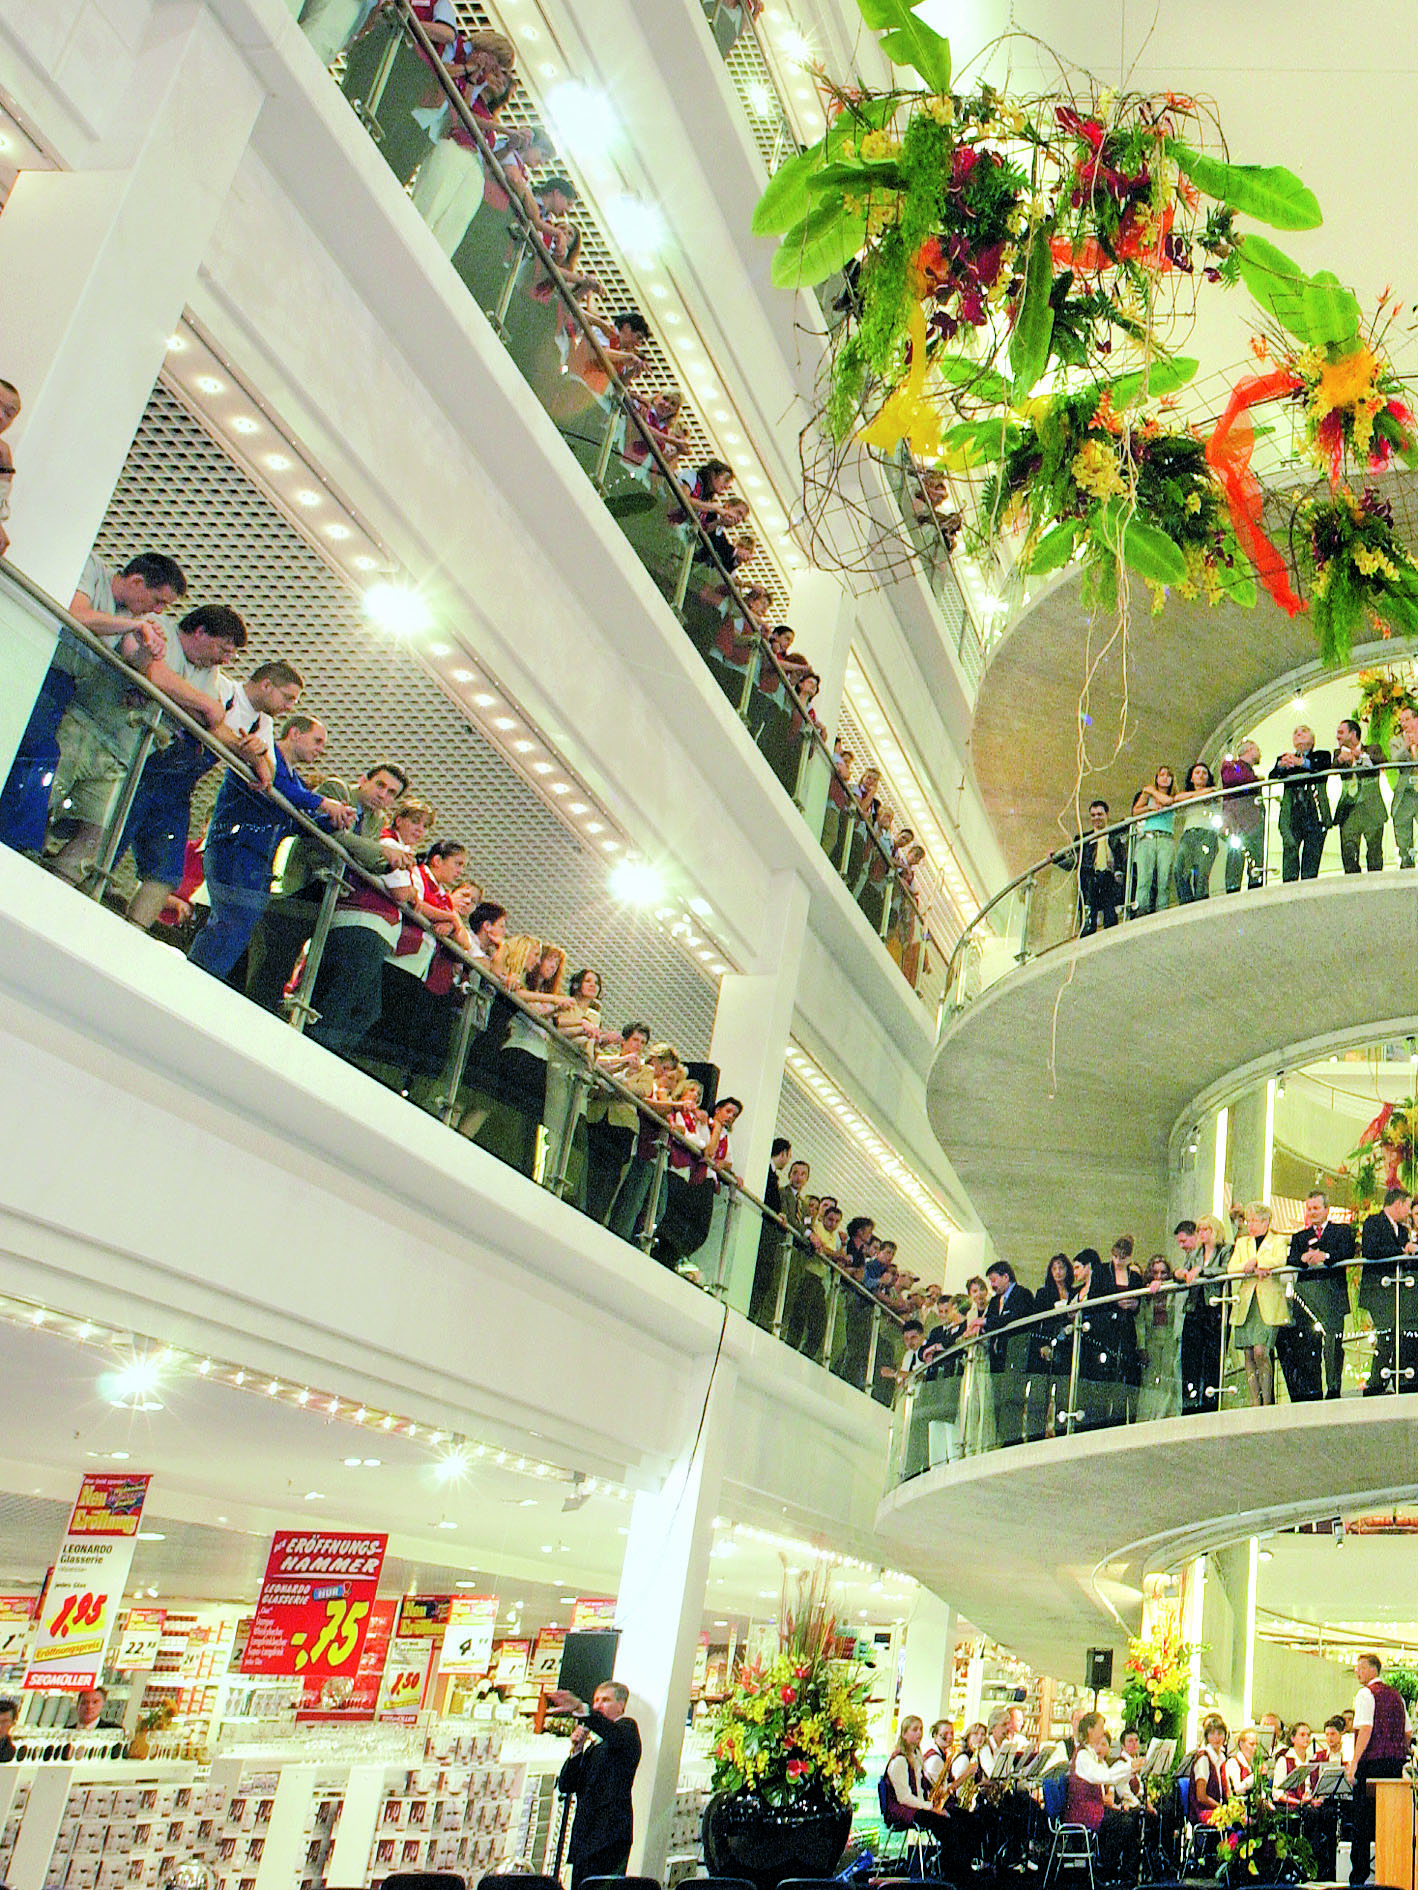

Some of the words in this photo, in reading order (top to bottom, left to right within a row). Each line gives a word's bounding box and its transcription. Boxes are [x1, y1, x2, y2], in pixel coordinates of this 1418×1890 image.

[62, 1544, 113, 1554] LEONARDO
[286, 1534, 383, 1555] ERÖFFNUNGS-
[60, 1555, 104, 1564] Glasserie
[280, 1556, 380, 1573] HAMMER
[264, 1583, 312, 1594] LEONARDO
[261, 1594, 310, 1605] GLASSERIE
[28, 1674, 93, 1686] SEGMÜLLER
